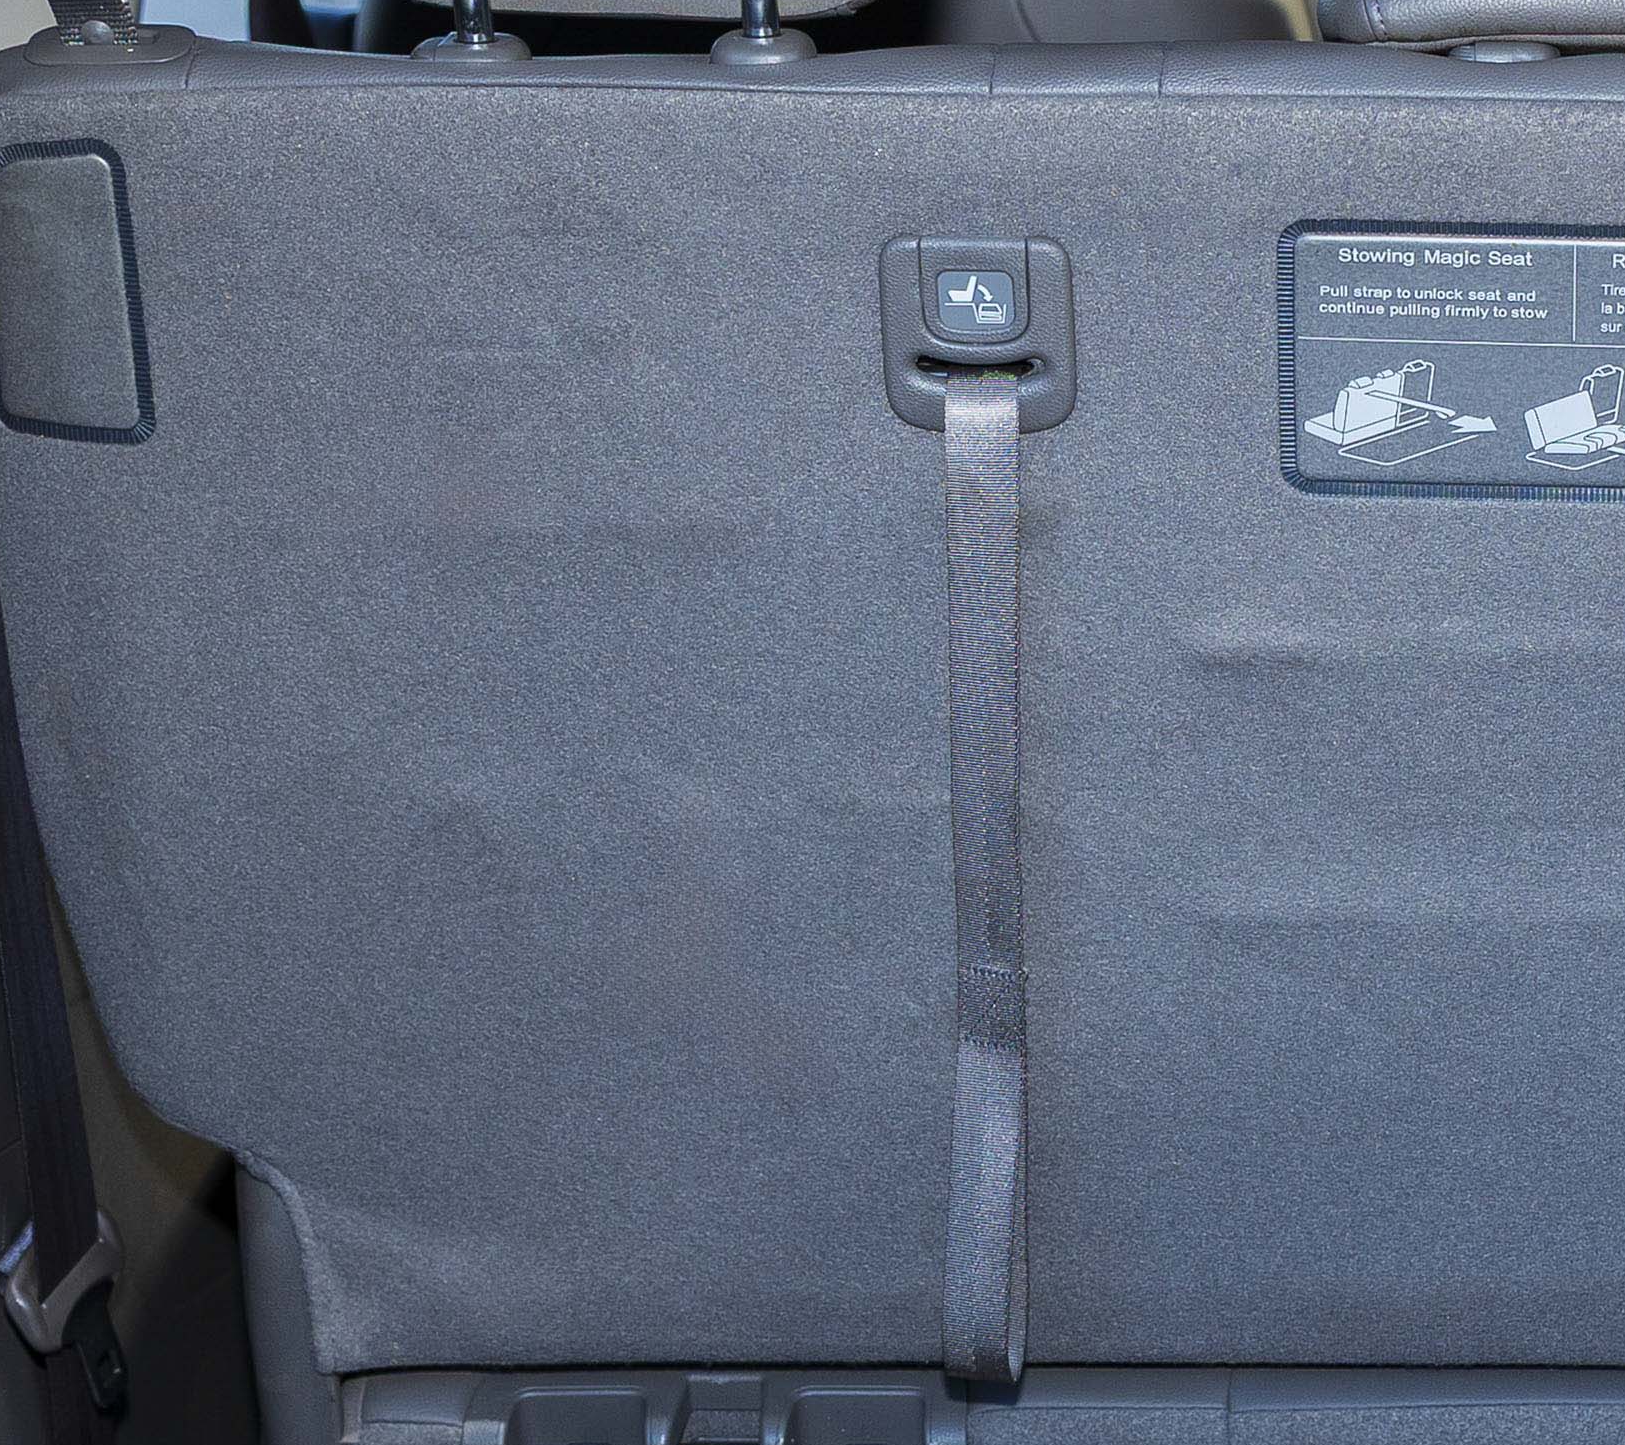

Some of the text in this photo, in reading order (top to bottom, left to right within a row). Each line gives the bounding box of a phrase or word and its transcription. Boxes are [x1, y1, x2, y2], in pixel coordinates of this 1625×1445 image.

[1338, 248, 1533, 268] Stowing Magic Seat
[1319, 285, 1536, 302] Pull strap to unlock seat and
[1319, 303, 1548, 319] continue pulling firmly to stow
[1601, 302, 1613, 314] la
[1600, 323, 1622, 333] sur
